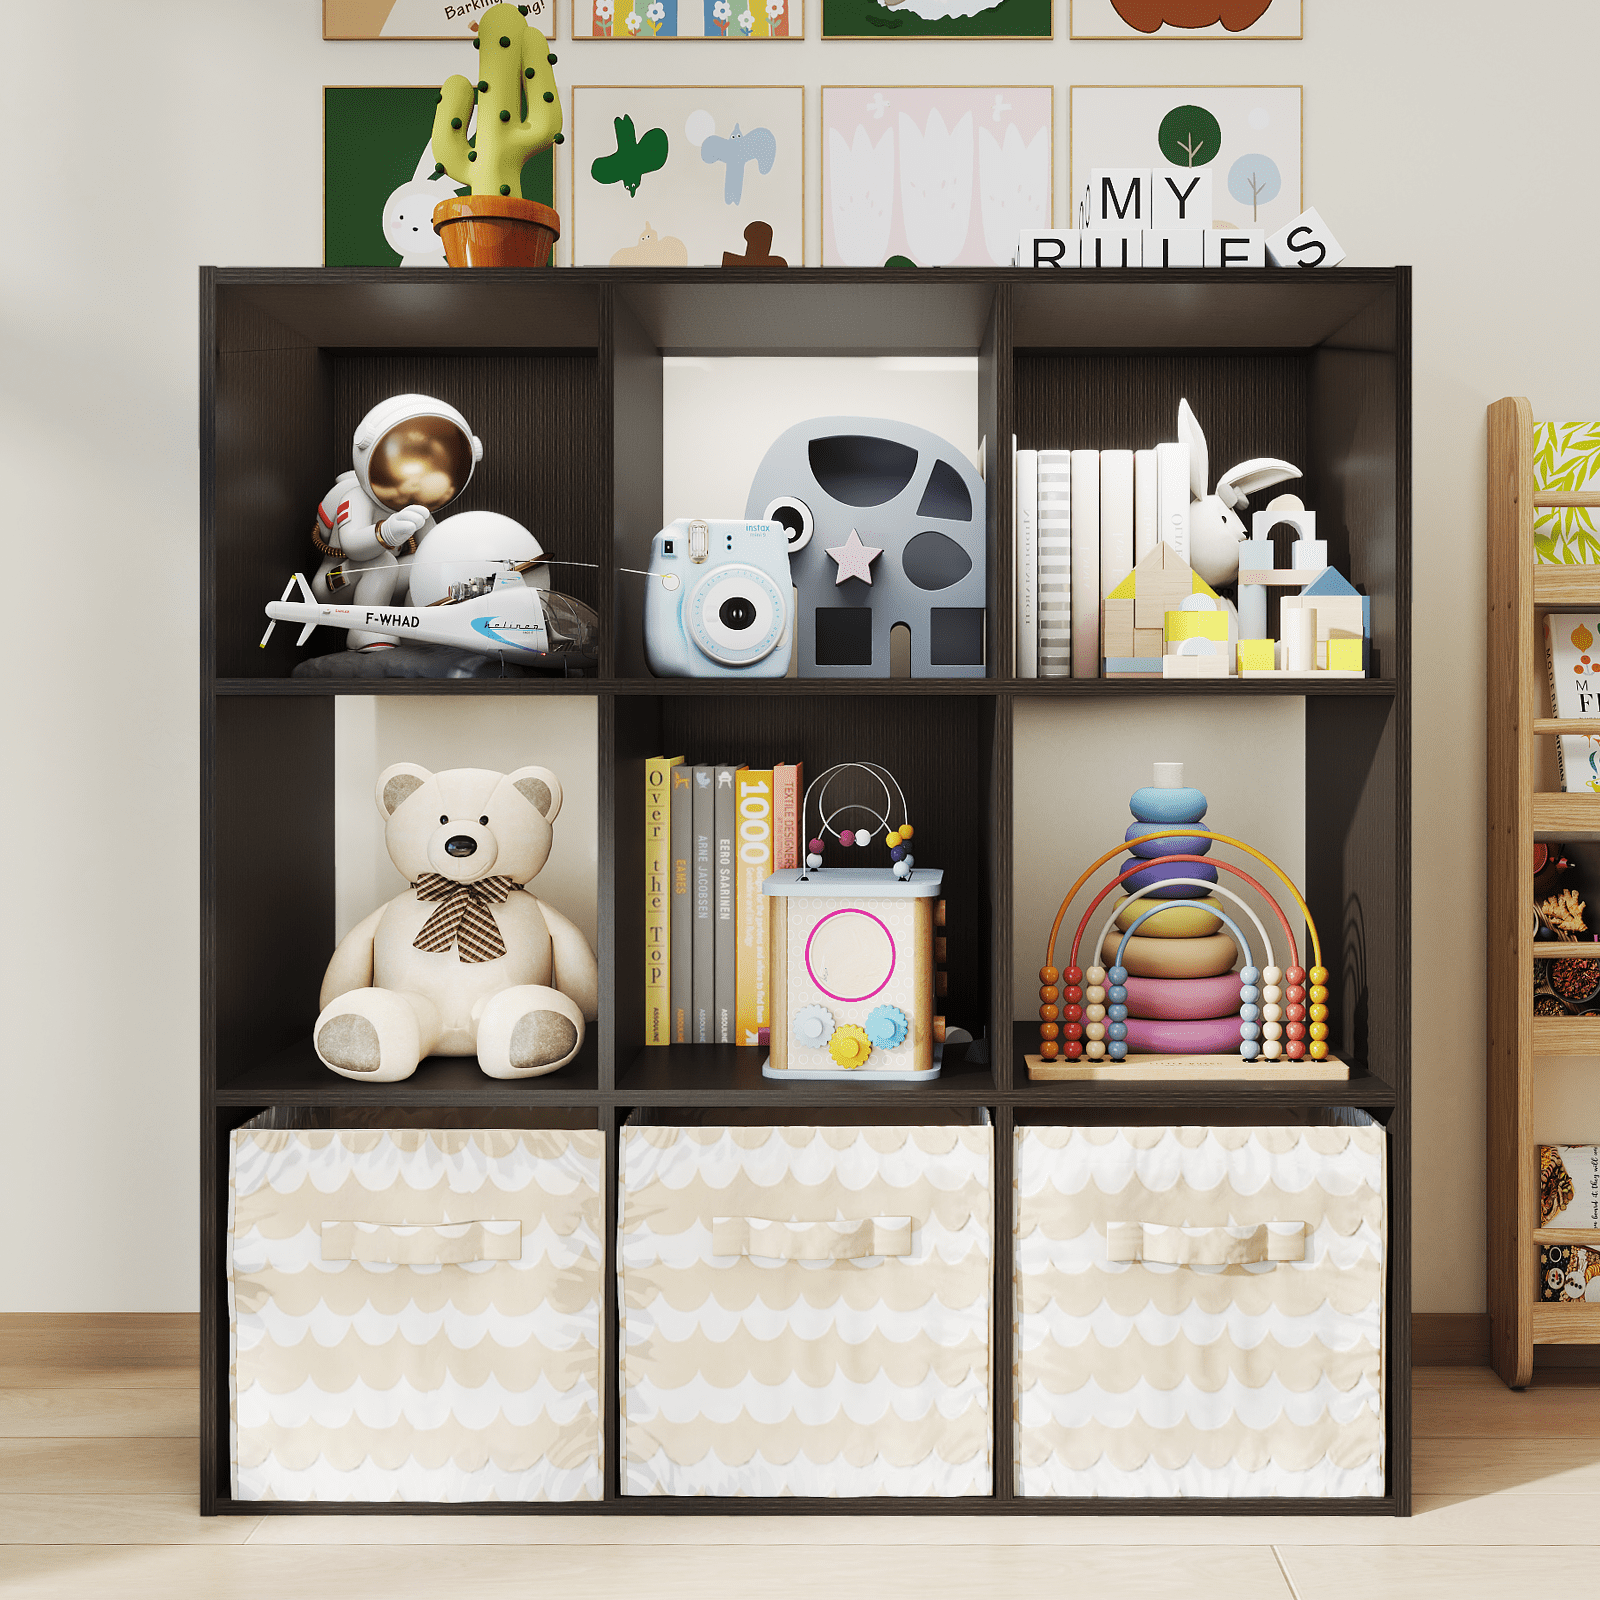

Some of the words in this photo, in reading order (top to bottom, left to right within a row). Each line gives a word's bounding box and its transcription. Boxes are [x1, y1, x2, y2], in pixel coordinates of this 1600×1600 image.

[1102, 177, 1200, 219] MY
[746, 523, 770, 532] instax
[365, 612, 420, 628] F-WHAD
[649, 770, 664, 837] Over
[784, 782, 794, 817] TEXTILE
[740, 780, 770, 864] 1000
[698, 835, 708, 862] ARNE
[720, 838, 731, 865] EERO
[651, 860, 662, 908] the
[675, 858, 687, 895] EAMES
[698, 867, 708, 919] JACOBSEN
[720, 868, 731, 920] SAARINEN
[649, 926, 663, 984] Top
[653, 1007, 661, 1043] ASSOULINE
